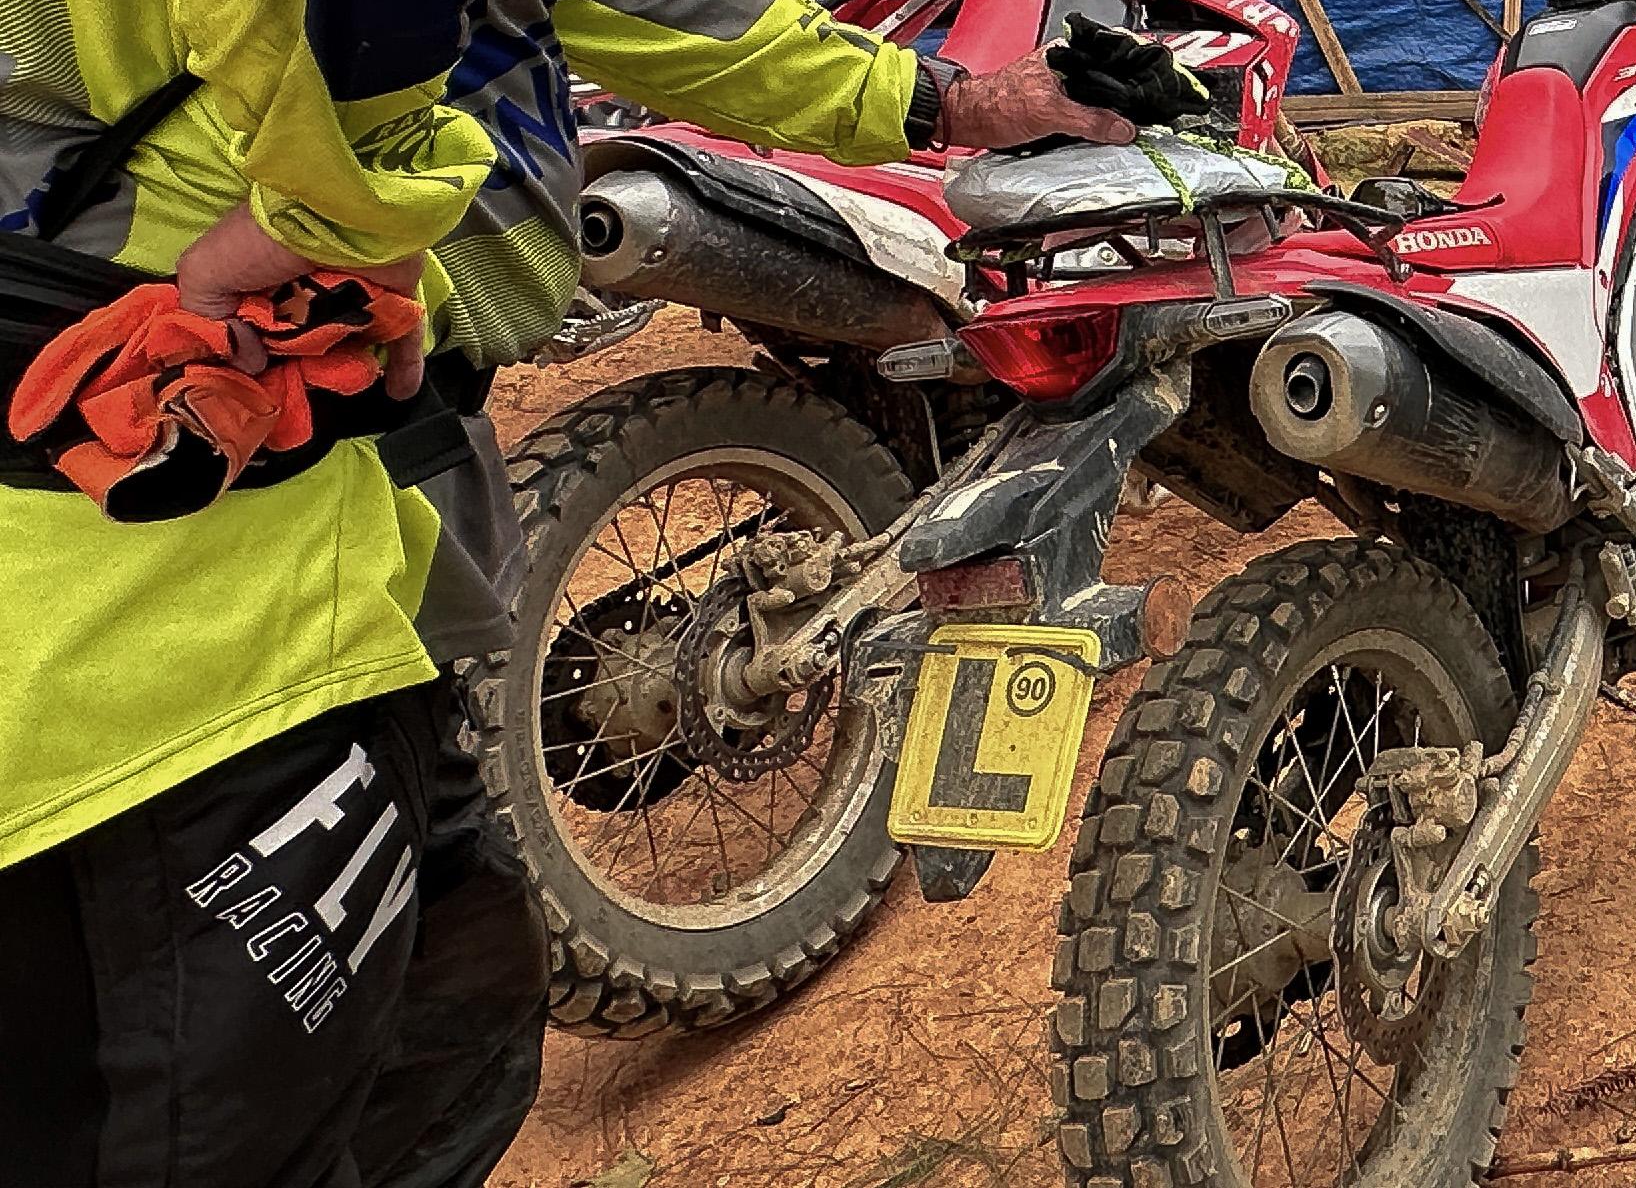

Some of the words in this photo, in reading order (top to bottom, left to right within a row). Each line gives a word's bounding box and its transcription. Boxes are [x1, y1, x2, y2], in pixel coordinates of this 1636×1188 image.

[1395, 227, 1493, 253] HONDA
[928, 658, 1033, 813] L
[1015, 676, 1046, 701] 90
[249, 743, 418, 975] FLY
[185, 853, 348, 1034] RACING
